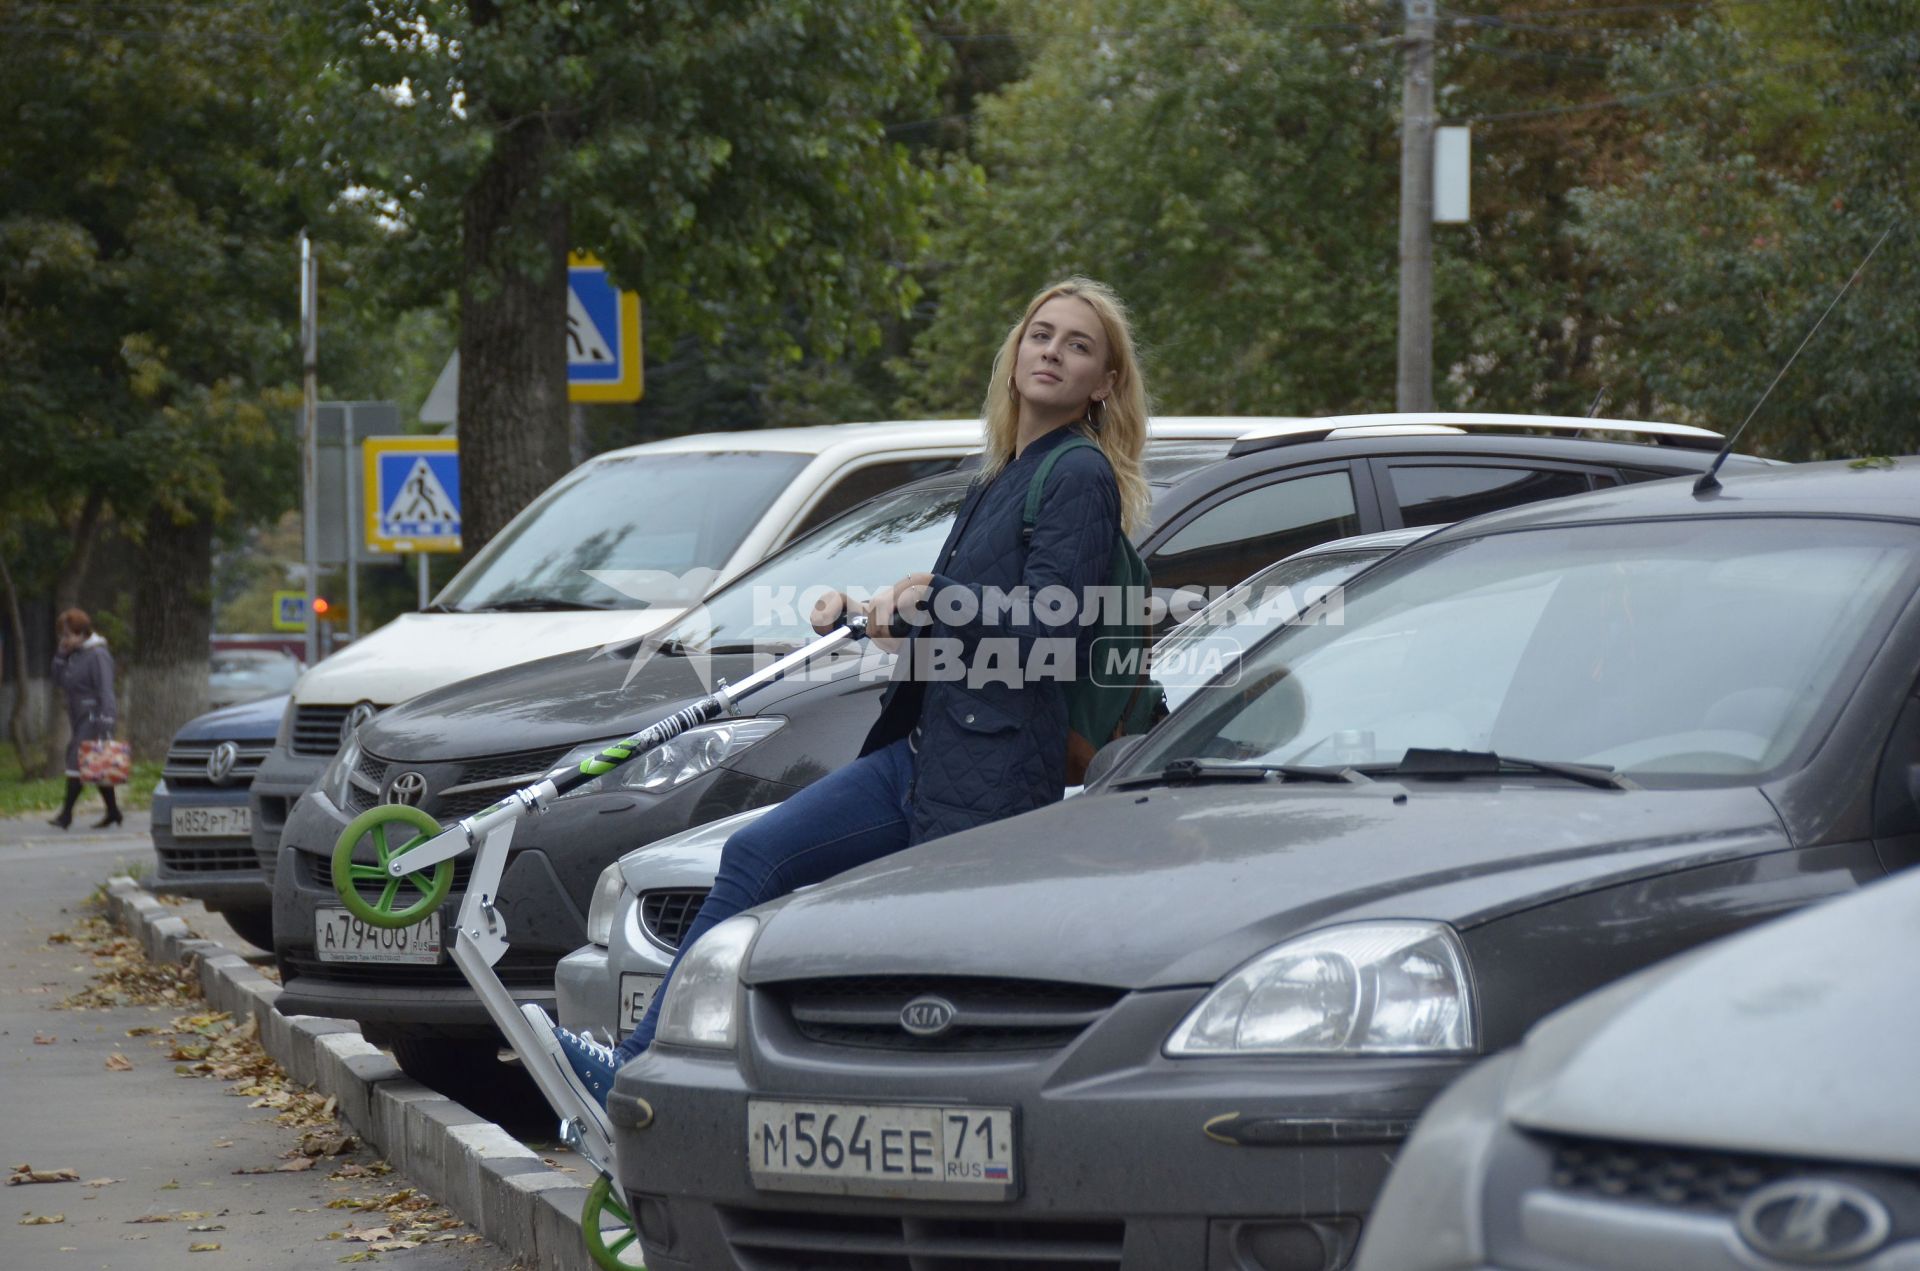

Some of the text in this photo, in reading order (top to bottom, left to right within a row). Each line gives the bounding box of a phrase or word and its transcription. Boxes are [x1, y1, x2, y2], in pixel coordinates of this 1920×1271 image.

[907, 1006, 943, 1025] KIA
[762, 1111, 994, 1175] М564ЕЕ 71
[947, 1161, 982, 1178] RUS
